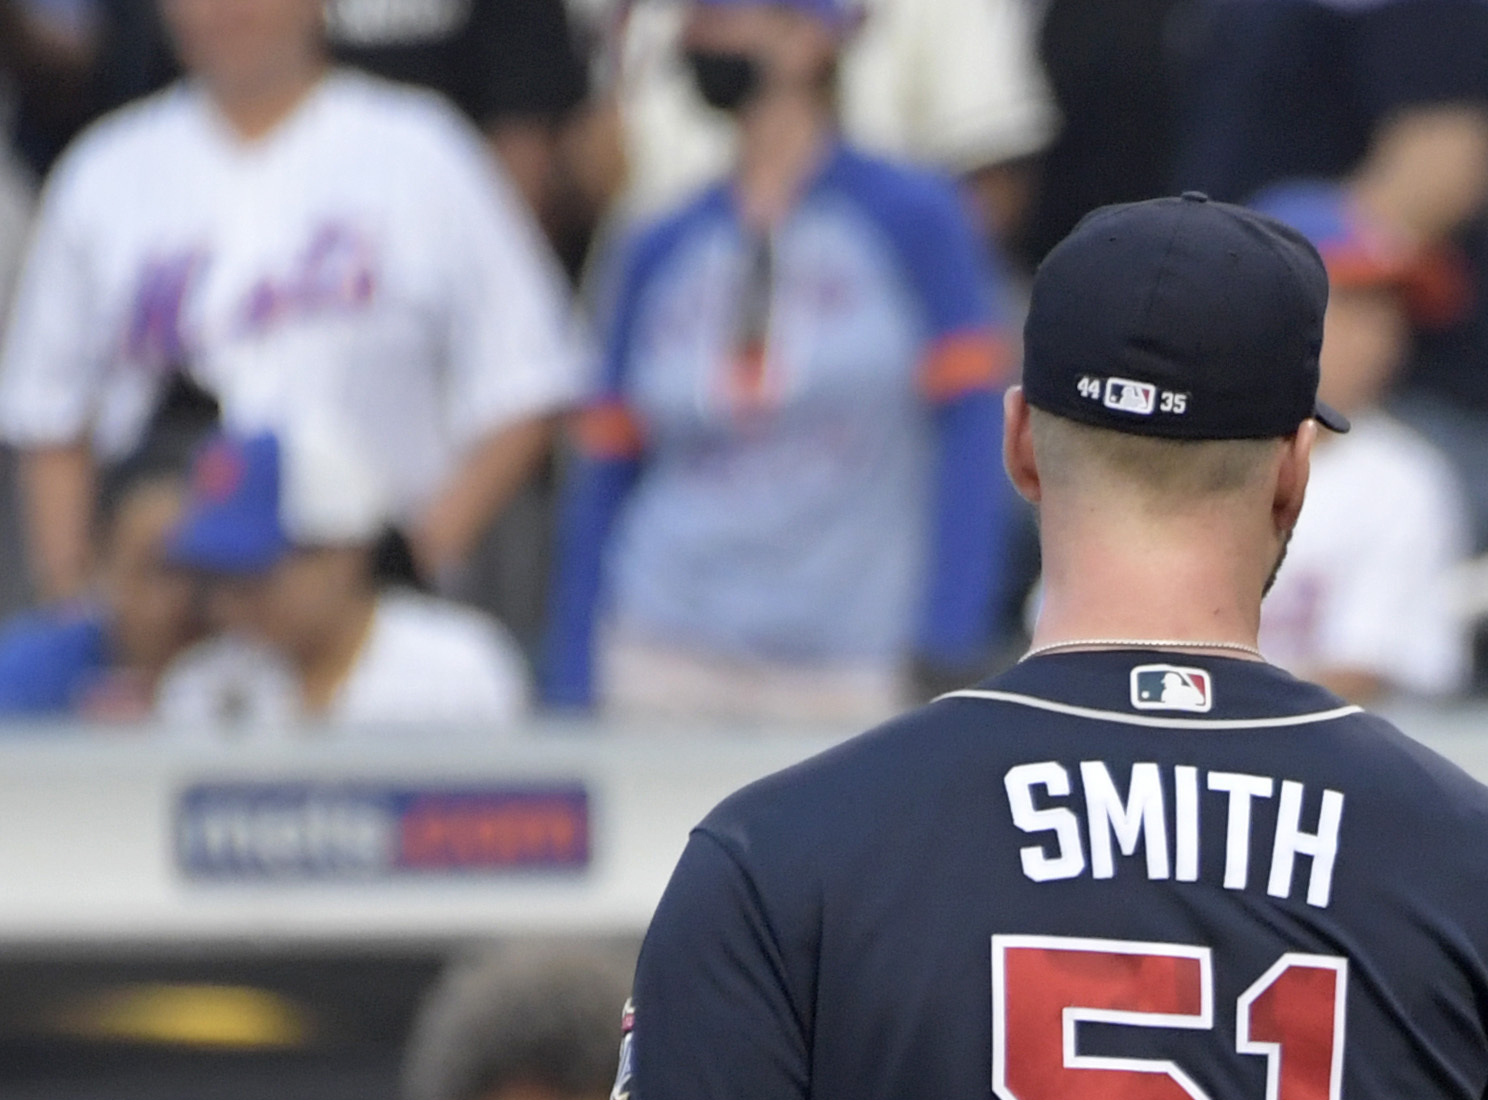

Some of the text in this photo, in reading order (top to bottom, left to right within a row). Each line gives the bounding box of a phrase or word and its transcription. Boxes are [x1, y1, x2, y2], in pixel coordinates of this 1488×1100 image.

[1077, 377, 1188, 414] 44 35
[1003, 761, 1345, 908] SMITH
